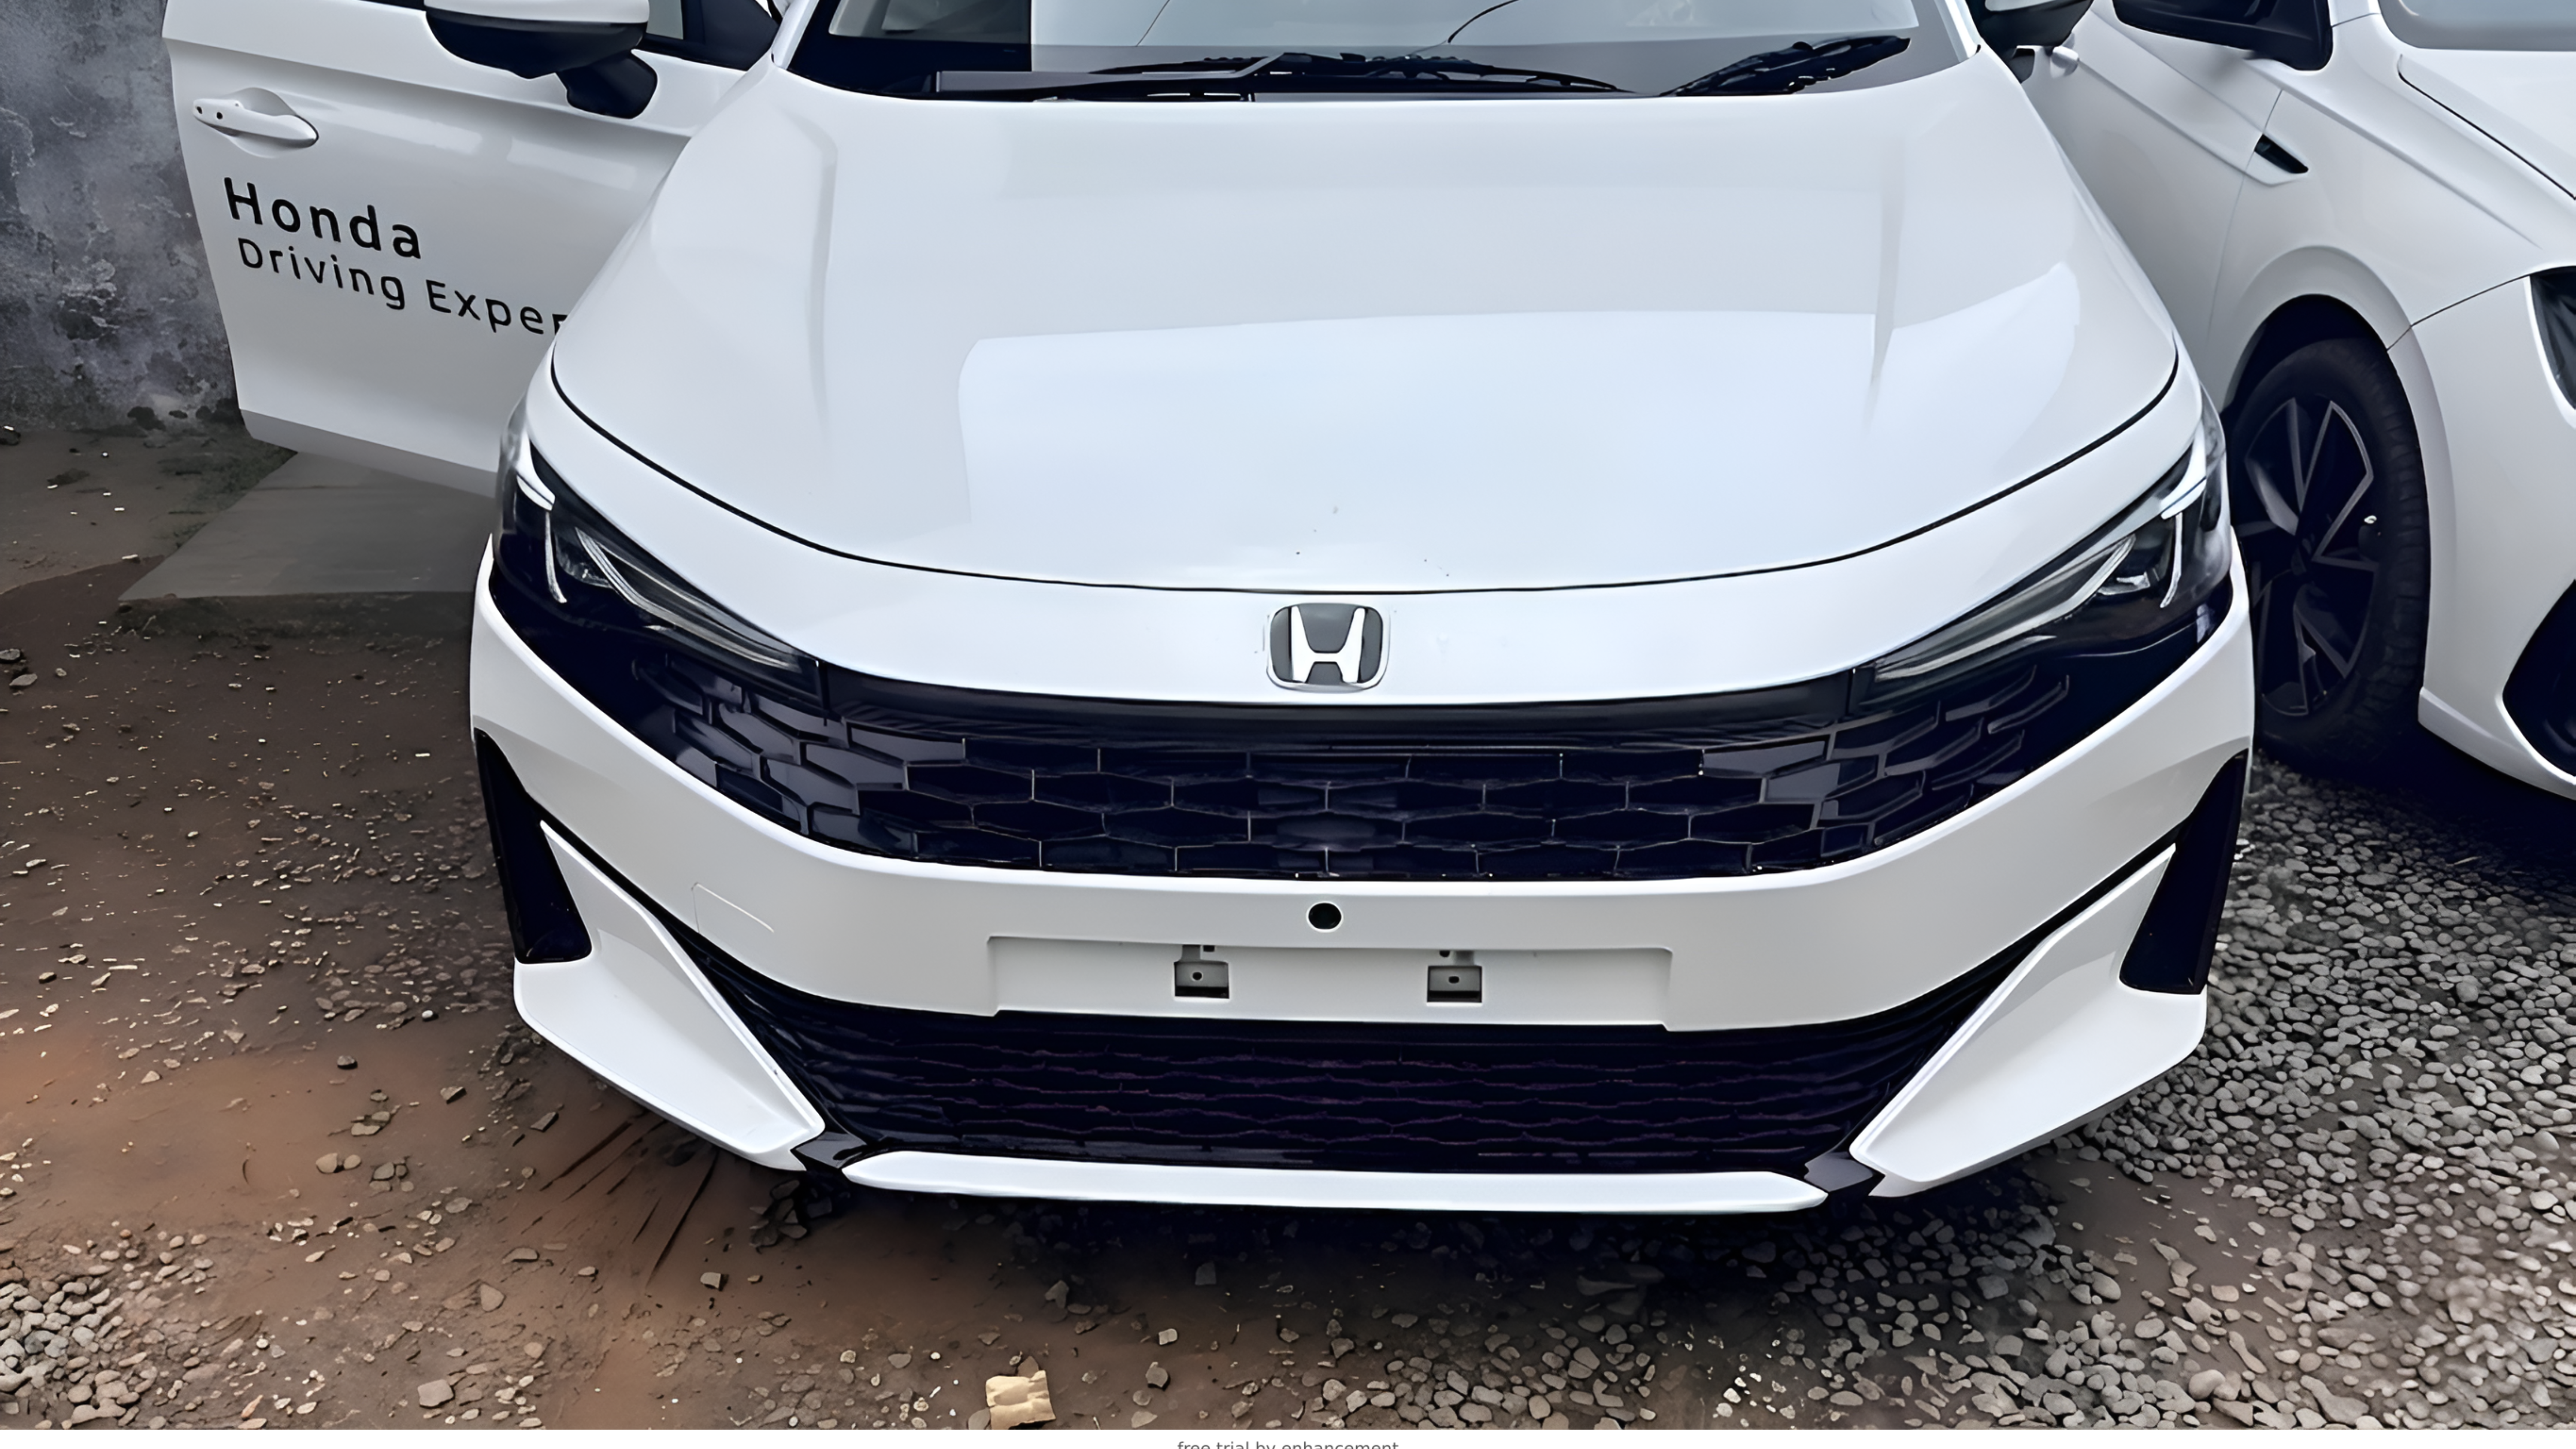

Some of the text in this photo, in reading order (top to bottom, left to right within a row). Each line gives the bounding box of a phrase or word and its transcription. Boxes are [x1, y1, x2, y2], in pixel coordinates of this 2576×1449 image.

[224, 177, 421, 259] Honda
[237, 237, 405, 311] Driving
[1290, 605, 1366, 684] H
